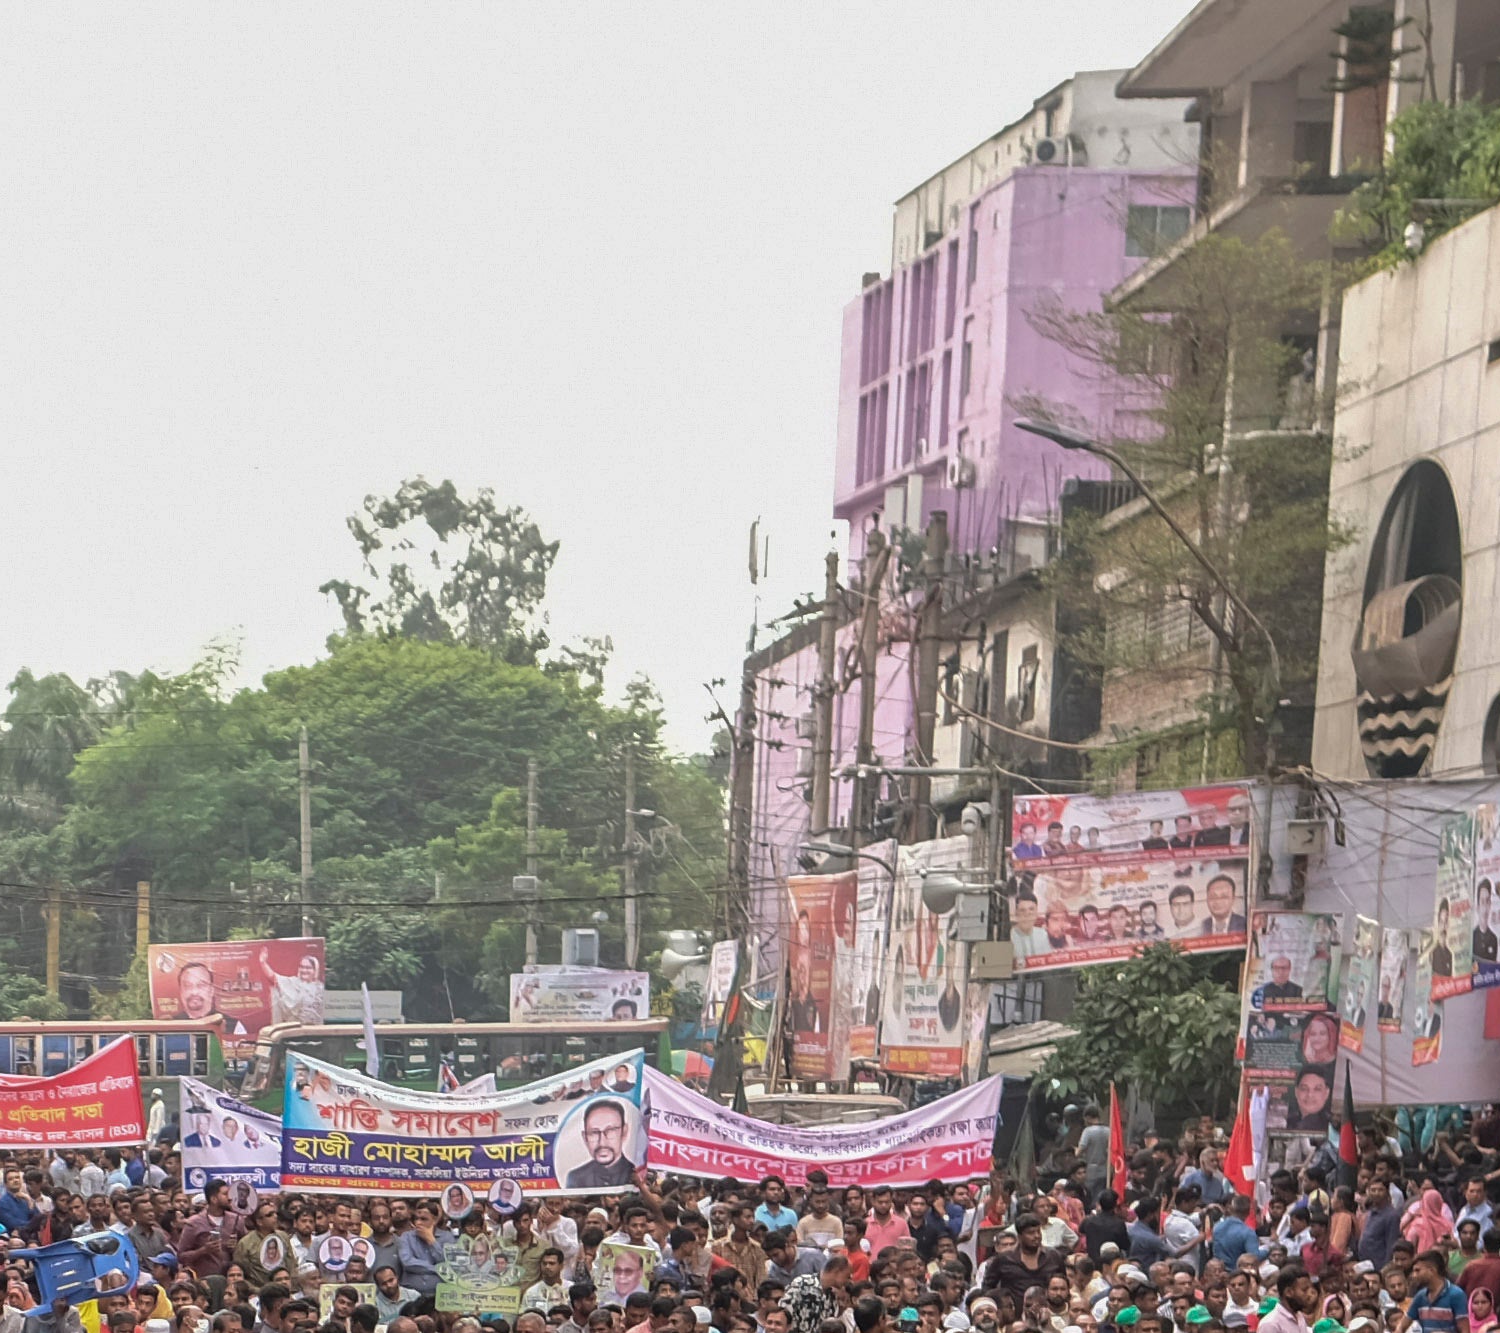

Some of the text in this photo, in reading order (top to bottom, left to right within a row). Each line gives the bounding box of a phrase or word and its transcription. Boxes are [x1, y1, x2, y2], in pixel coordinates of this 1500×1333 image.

[7, 1104, 67, 1124] প্রতিবাদ
[71, 1101, 105, 1119] সভা
[316, 1098, 384, 1131] শান্তি
[391, 1107, 503, 1137] সমাবেশ
[503, 1116, 531, 1130] সফল
[663, 1109, 711, 1134] বানচালের
[291, 1131, 550, 1167] হাজী মোহাম্মদ আলী
[649, 1135, 812, 1178] বাংলাদেশের
[821, 1151, 929, 1179] ওয়ার্কার্স
